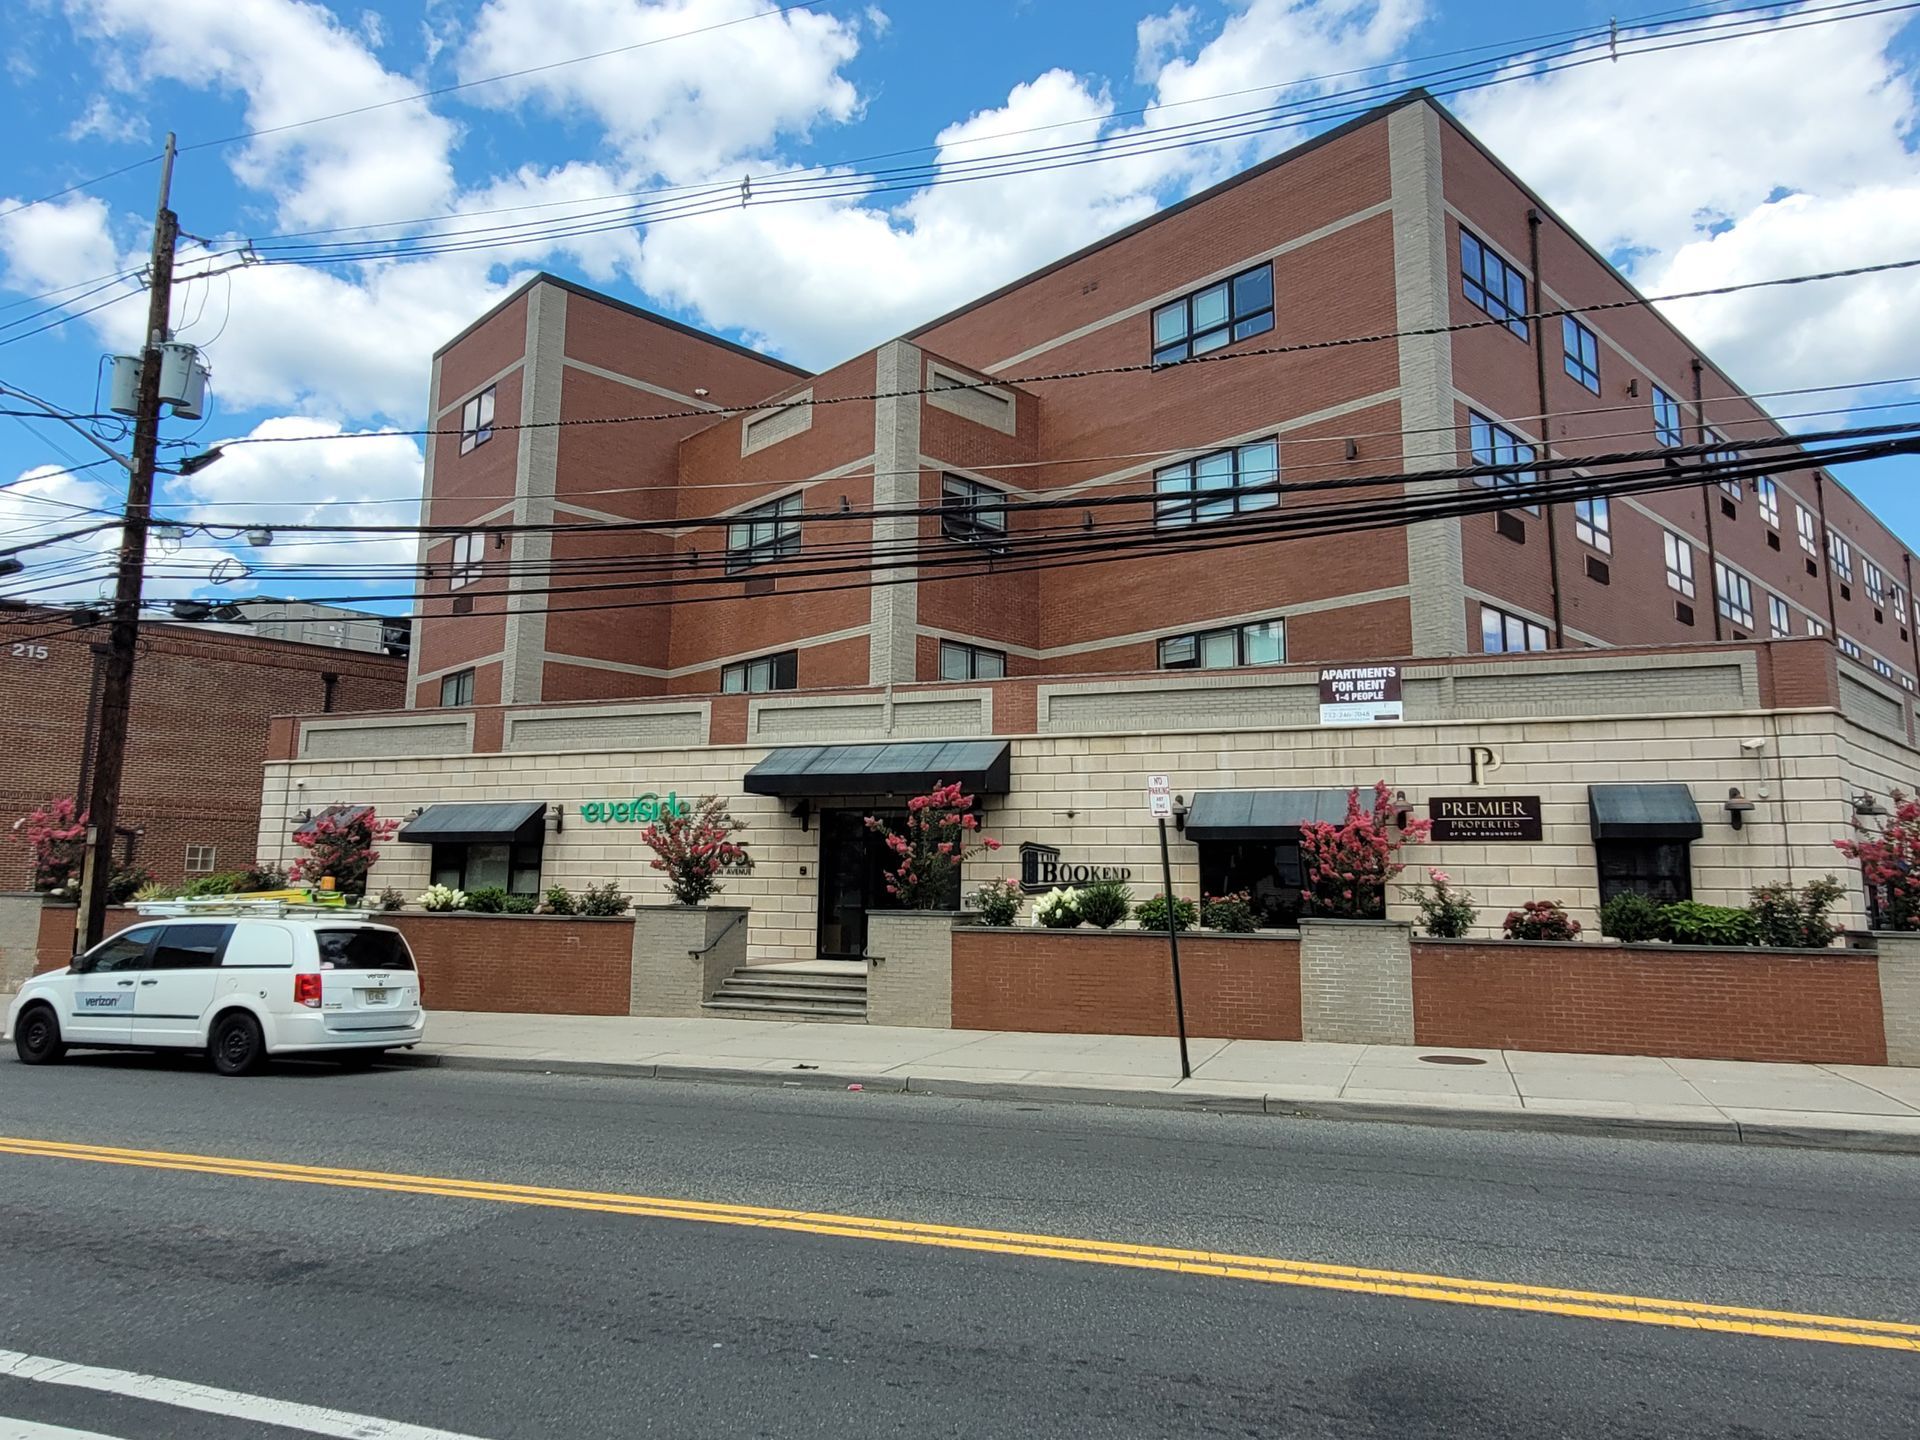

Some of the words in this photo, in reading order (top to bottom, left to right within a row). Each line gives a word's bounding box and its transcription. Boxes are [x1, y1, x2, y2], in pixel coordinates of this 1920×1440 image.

[12, 643, 49, 660] 215
[1321, 666, 1397, 681] APARTMENTS
[1331, 681, 1354, 692] FOR
[1356, 679, 1387, 691] RENT
[1334, 693, 1350, 701] 1-4
[1351, 691, 1385, 701] PEOPLE
[1153, 777, 1163, 786] NO
[579, 791, 691, 823] everside
[1441, 801, 1528, 816] PREMIER
[1451, 820, 1521, 829] PROPERTIES
[1040, 853, 1059, 862] THE
[726, 868, 752, 876] AVENUE
[1042, 862, 1132, 883] BOOKEND
[85, 995, 118, 1007] verizon
